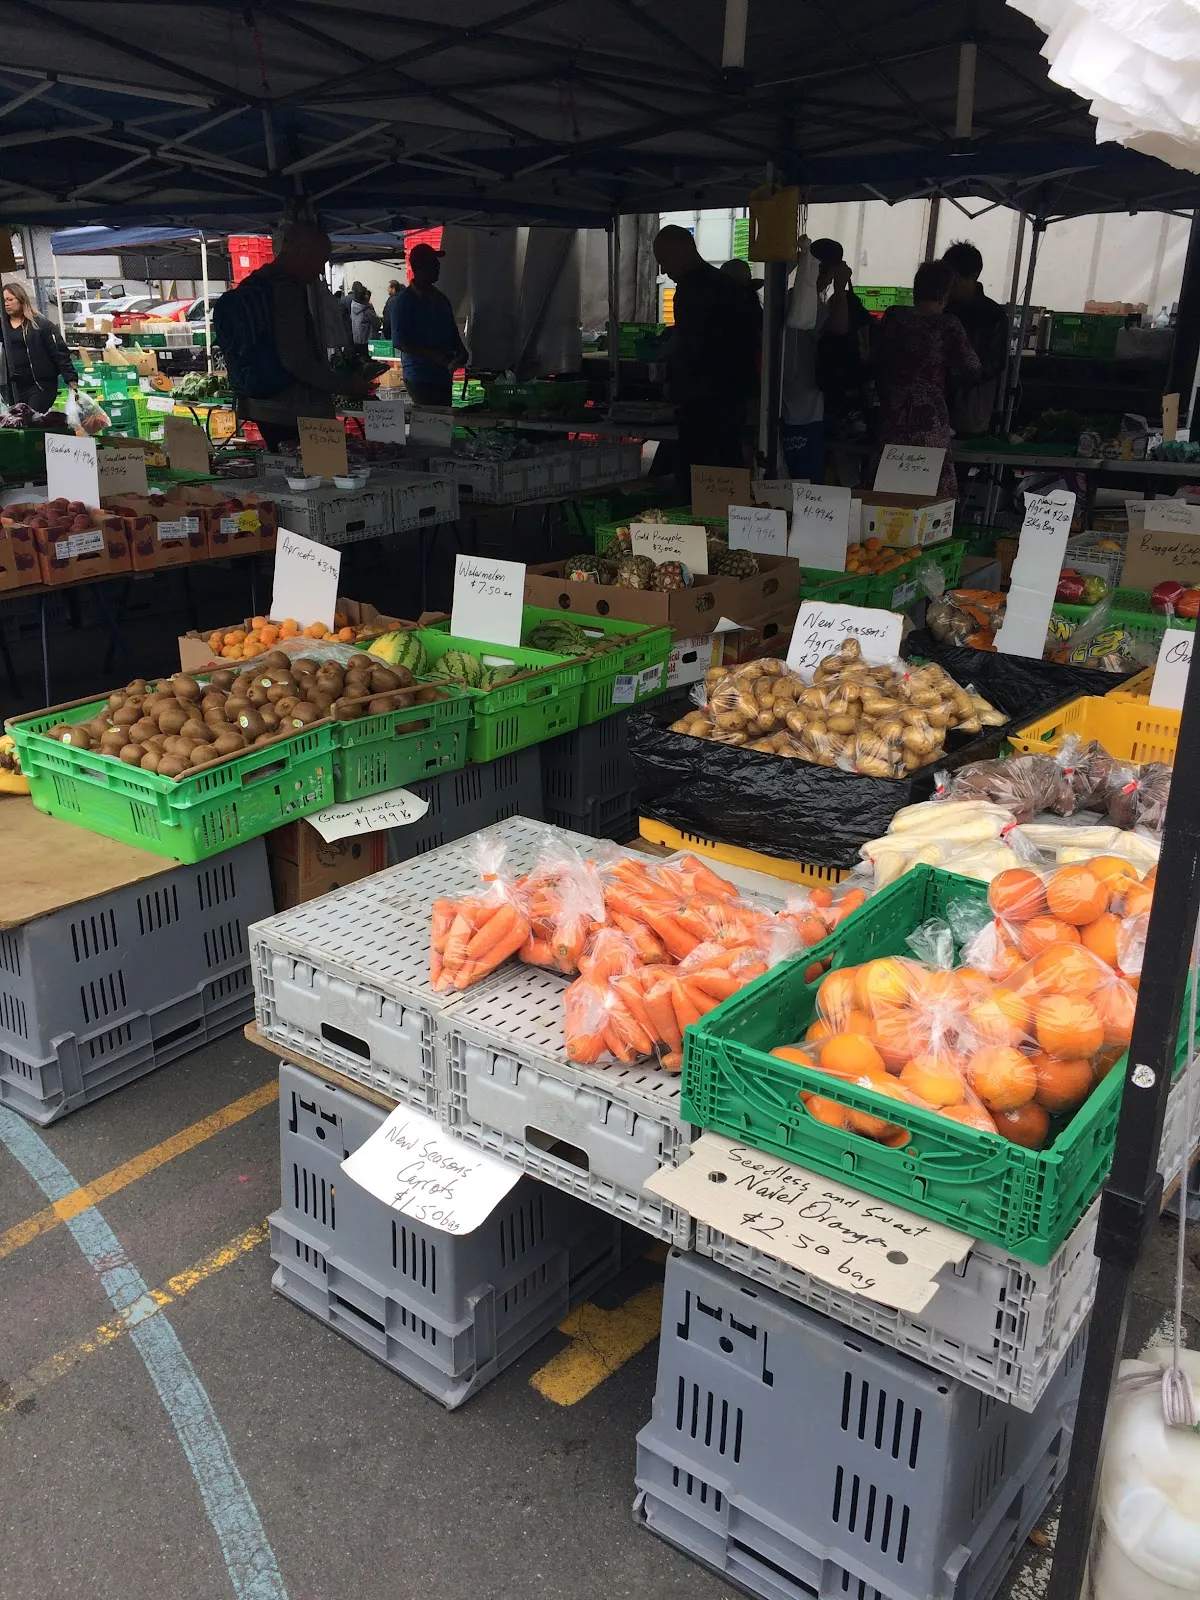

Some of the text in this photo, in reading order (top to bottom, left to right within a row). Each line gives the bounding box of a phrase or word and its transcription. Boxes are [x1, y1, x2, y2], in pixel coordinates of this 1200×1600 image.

[470, 580, 501, 596] $7.50
[802, 610, 836, 630] New
[318, 810, 354, 824] Green
[384, 1121, 419, 1152] New
[396, 1160, 459, 1201] Carrots
[727, 1146, 932, 1244] Seedless and Sweet
[734, 1173, 891, 1249] Navel Oranges
[742, 1211, 832, 1258] $2.50
[837, 1257, 878, 1291] bag
